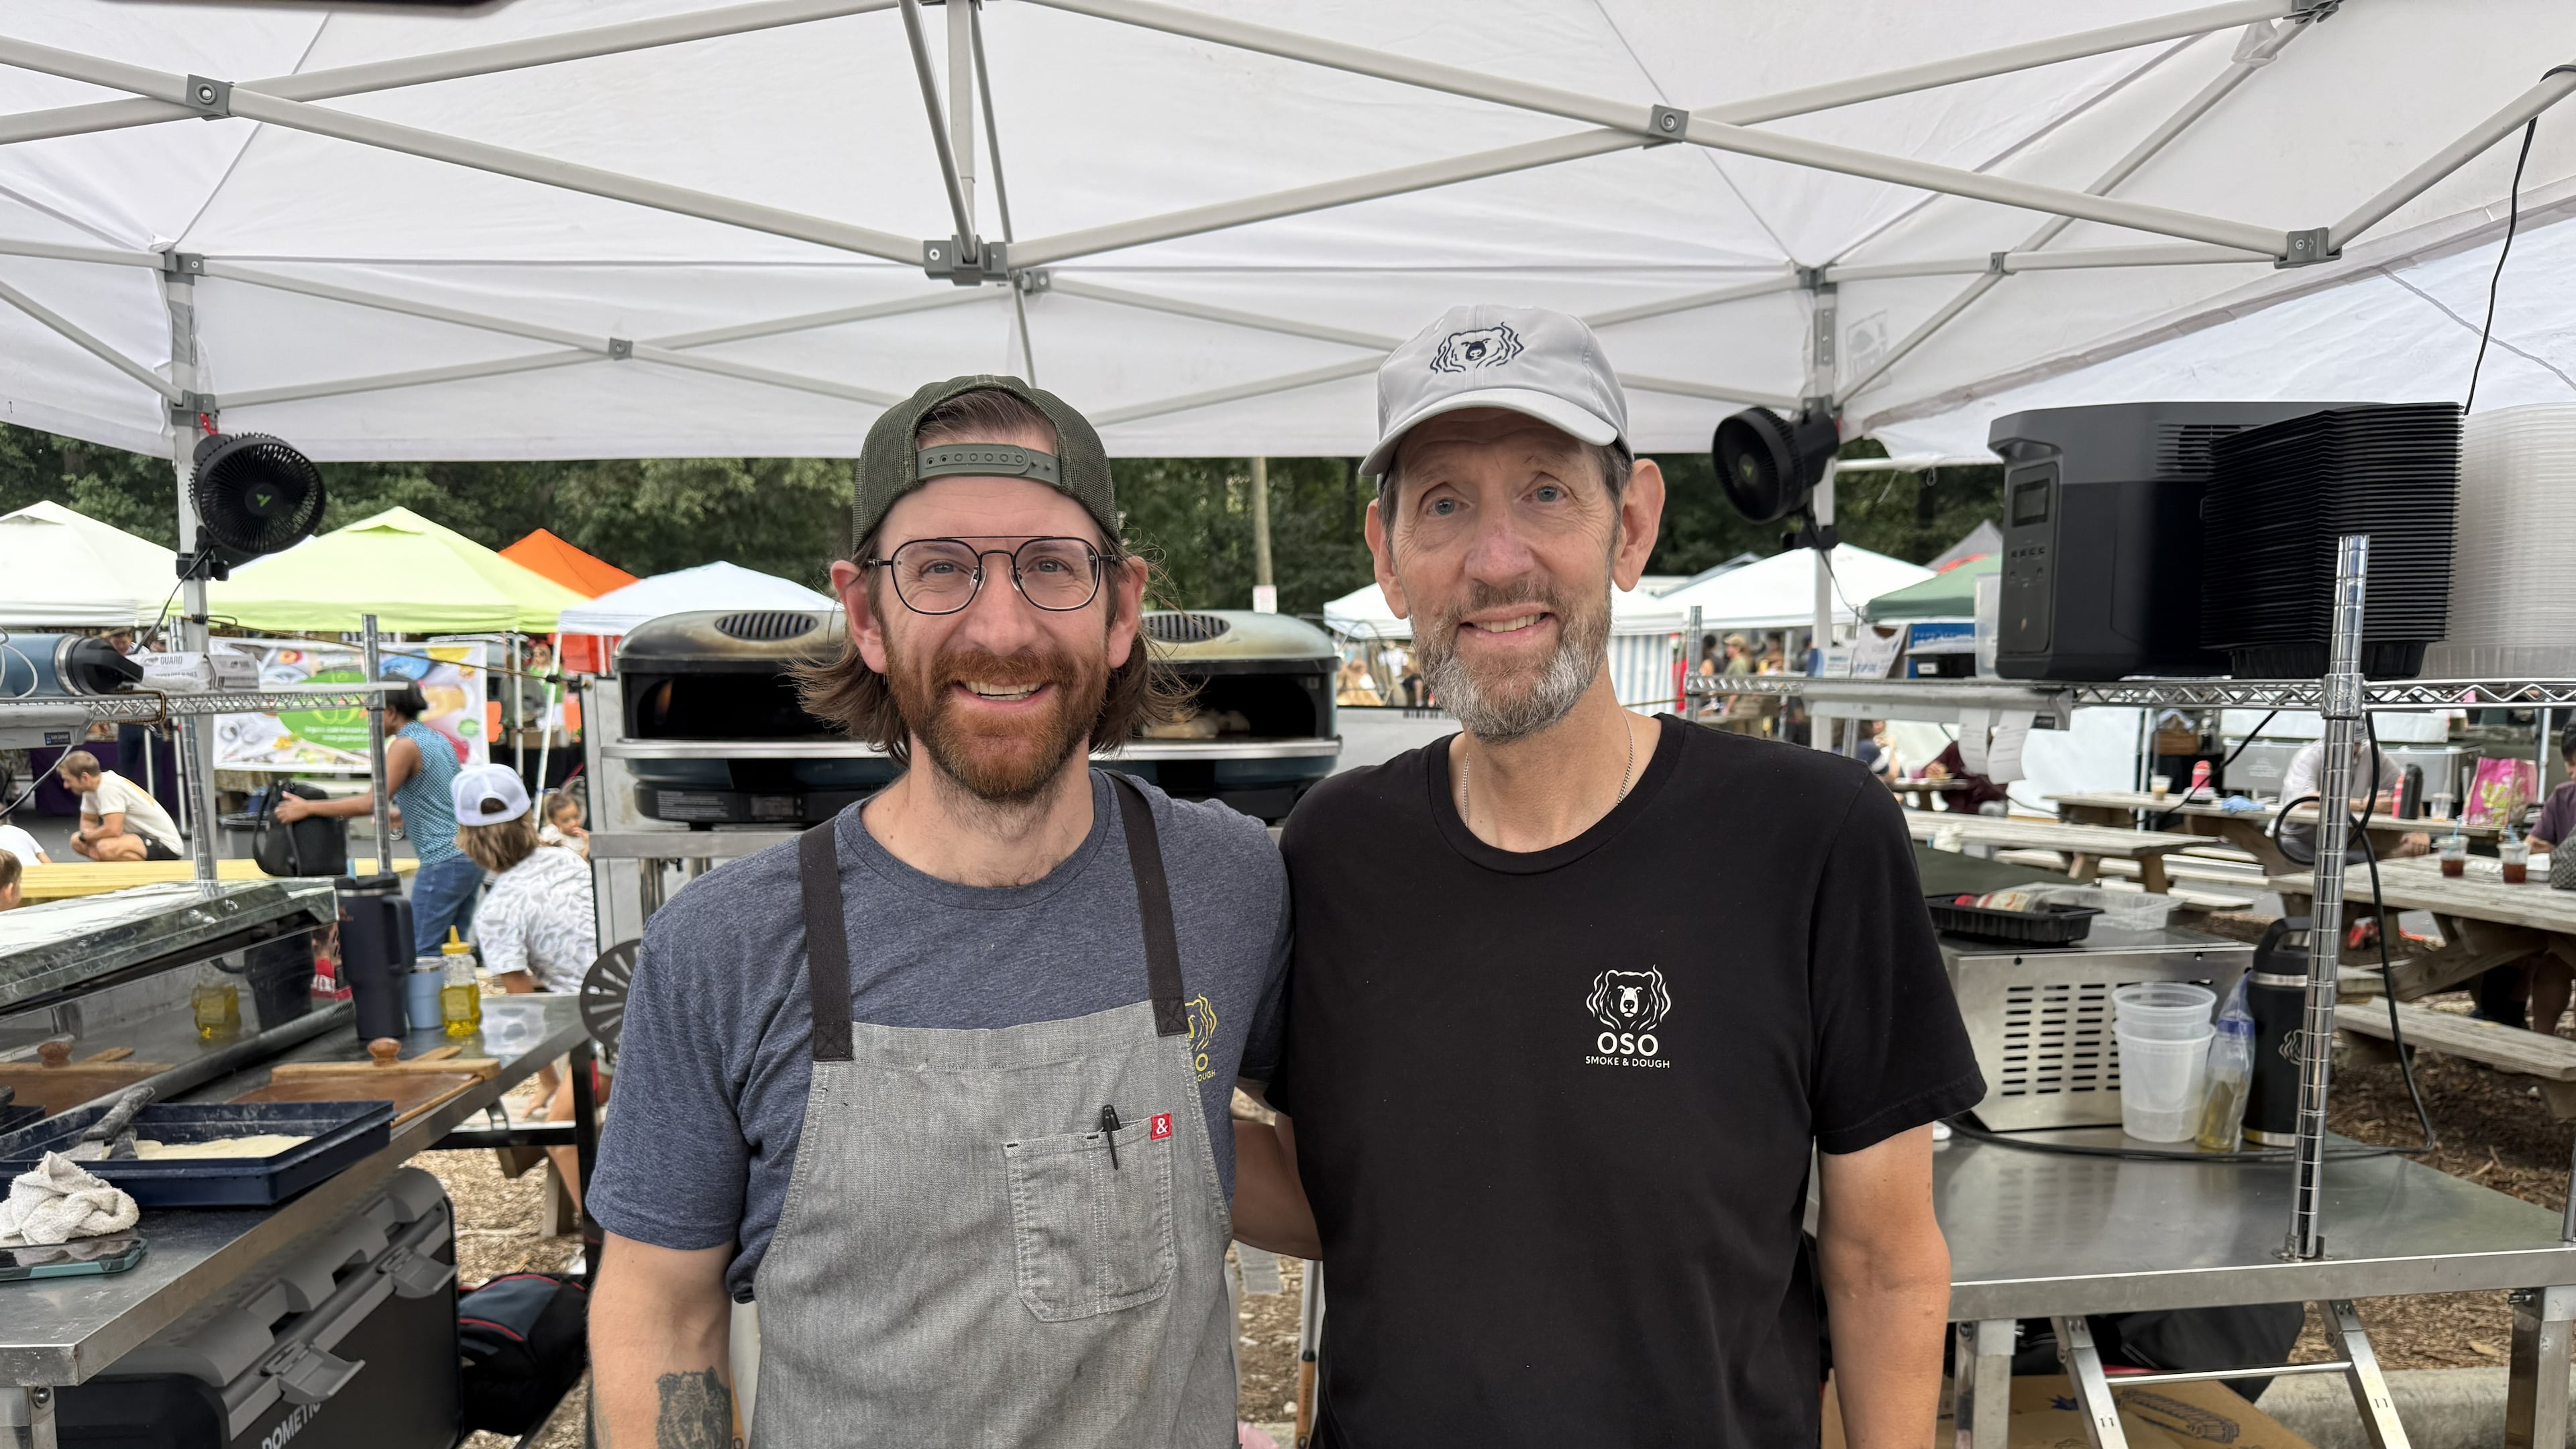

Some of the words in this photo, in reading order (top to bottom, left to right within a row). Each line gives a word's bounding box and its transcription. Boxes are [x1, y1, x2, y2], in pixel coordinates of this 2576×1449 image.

[160, 655, 183, 665] GUARD
[1597, 1032, 1659, 1057] OSO
[1585, 1055, 1619, 1066] SMOKE
[1622, 1057, 1629, 1067] &
[1631, 1058, 1670, 1069] DOUGH
[1197, 1069, 1216, 1082] OUGH
[1156, 1117, 1169, 1134] &
